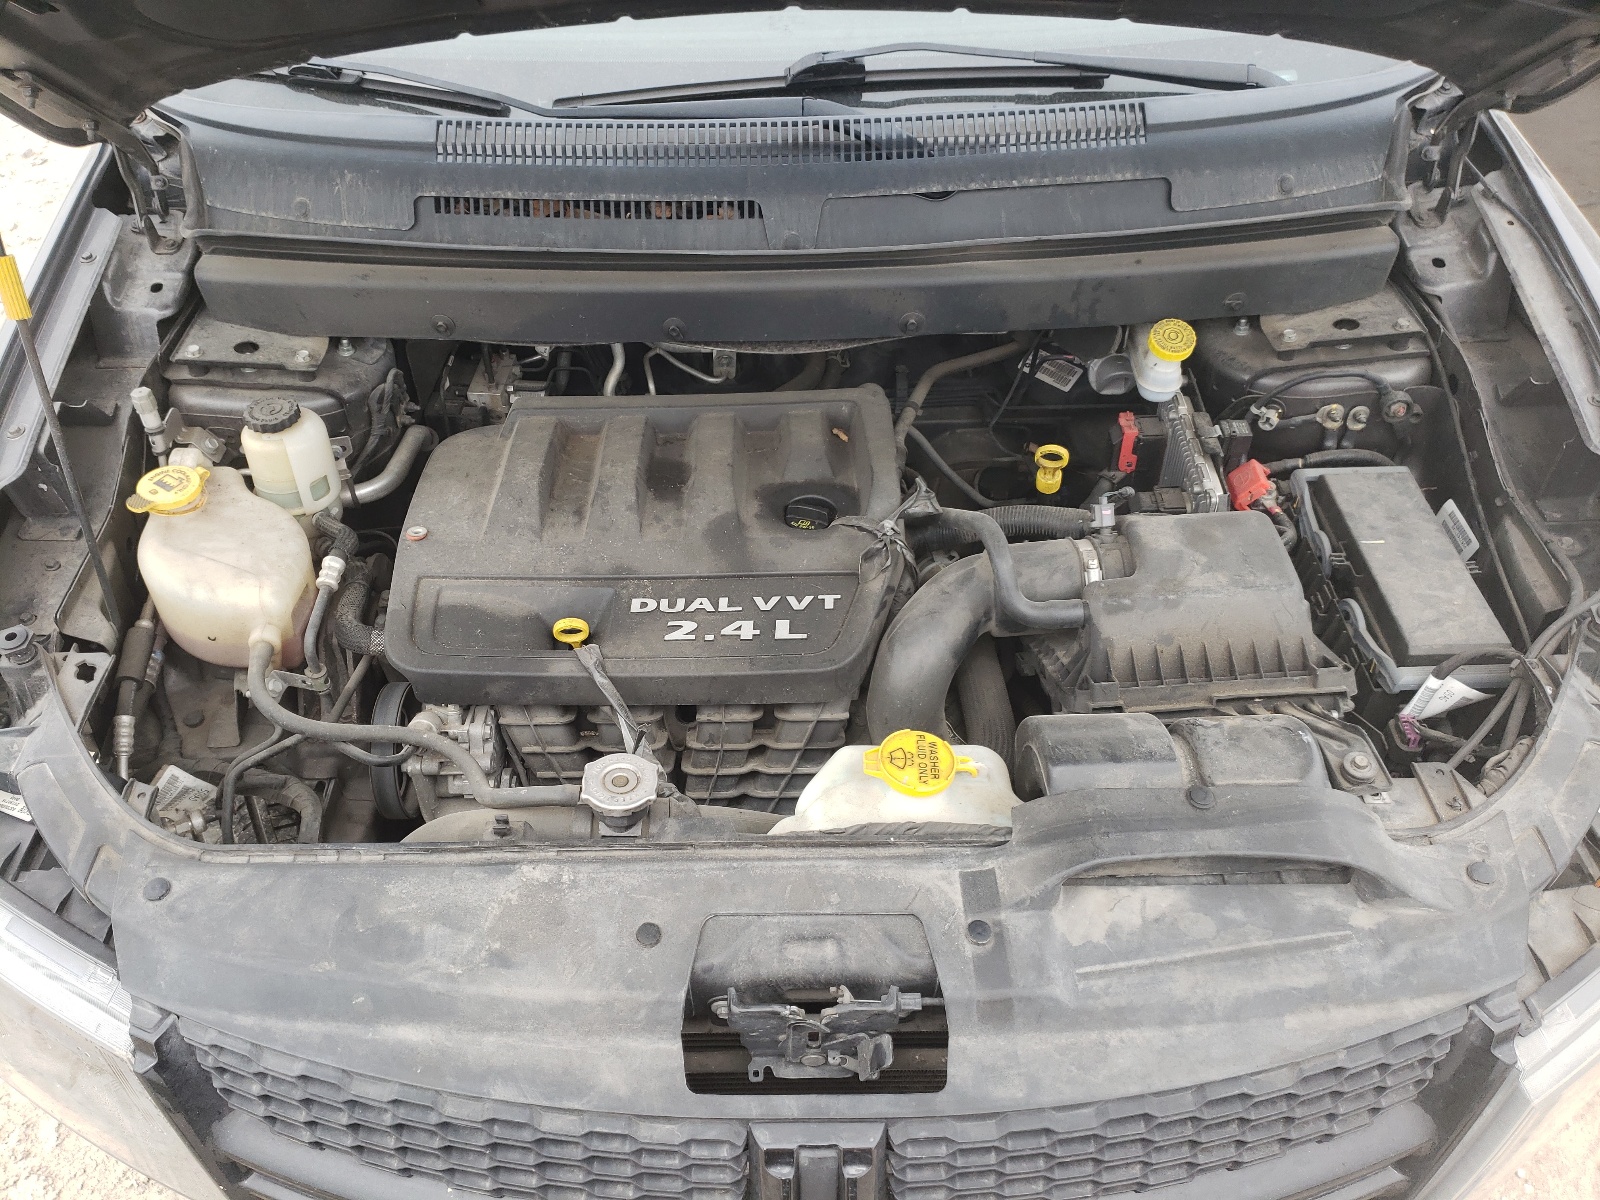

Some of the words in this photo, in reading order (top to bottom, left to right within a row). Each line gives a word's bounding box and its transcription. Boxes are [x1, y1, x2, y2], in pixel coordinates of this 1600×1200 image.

[630, 597, 743, 613] DUAL
[752, 594, 841, 611] VVT
[916, 734, 927, 760] FLUID
[928, 741, 940, 780] WASHER
[918, 763, 929, 785] ONLY
